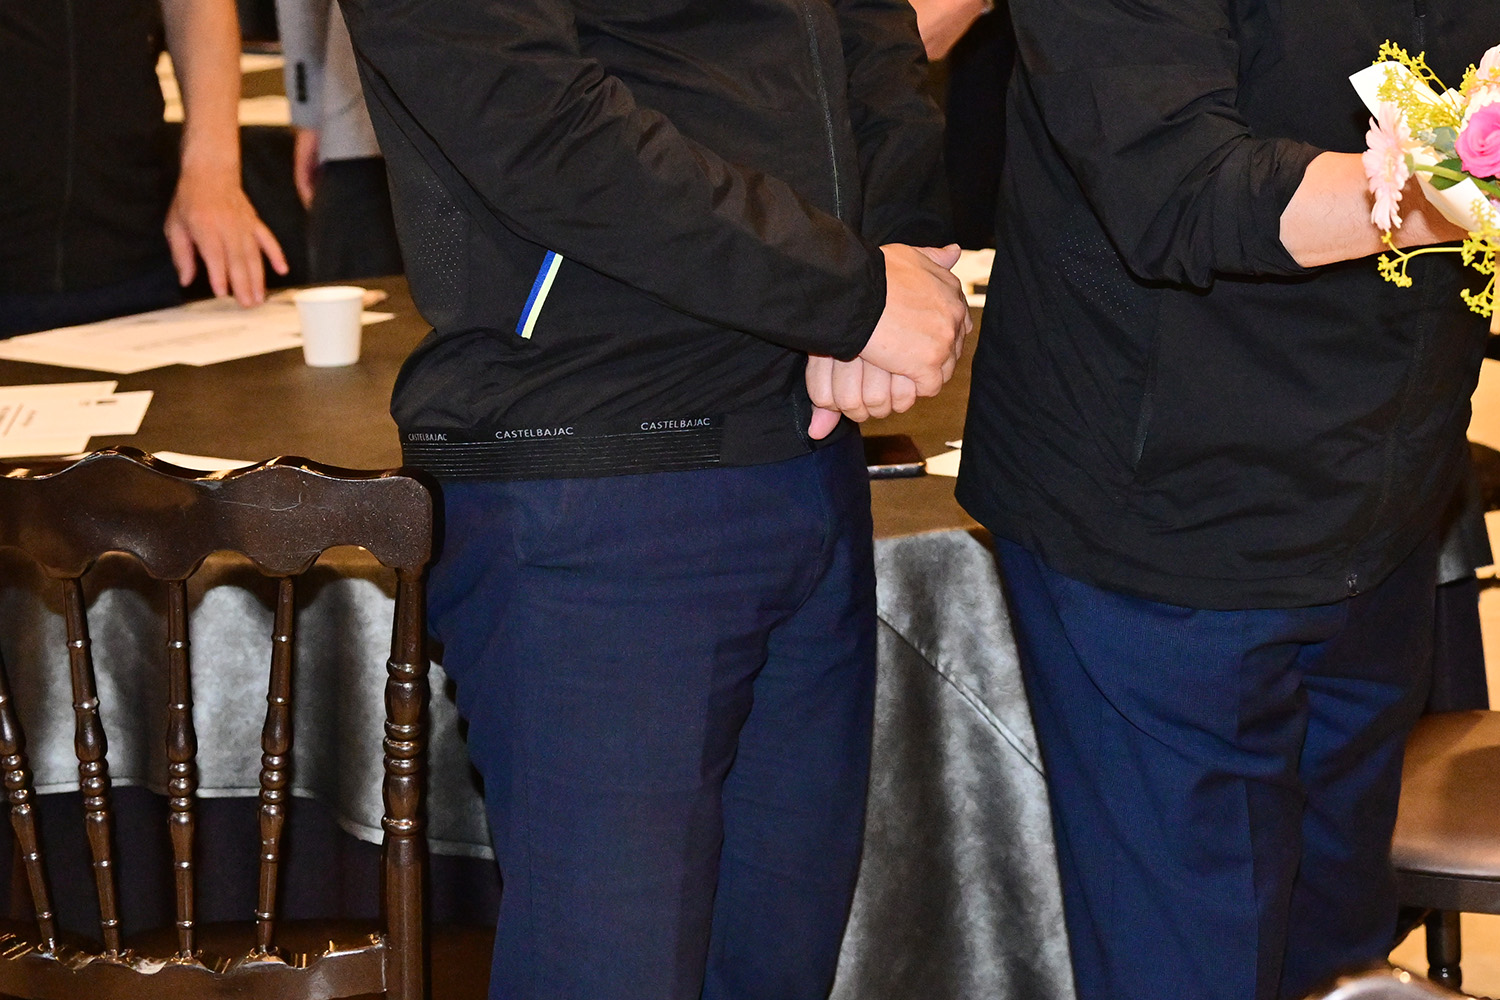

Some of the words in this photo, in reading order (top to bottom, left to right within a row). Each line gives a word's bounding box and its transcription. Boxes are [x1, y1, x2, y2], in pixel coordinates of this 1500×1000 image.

[408, 433, 448, 442] CASTELBAJAC
[495, 426, 574, 440] CASTELBAJAC
[640, 418, 711, 431] CASTELBAJAC
